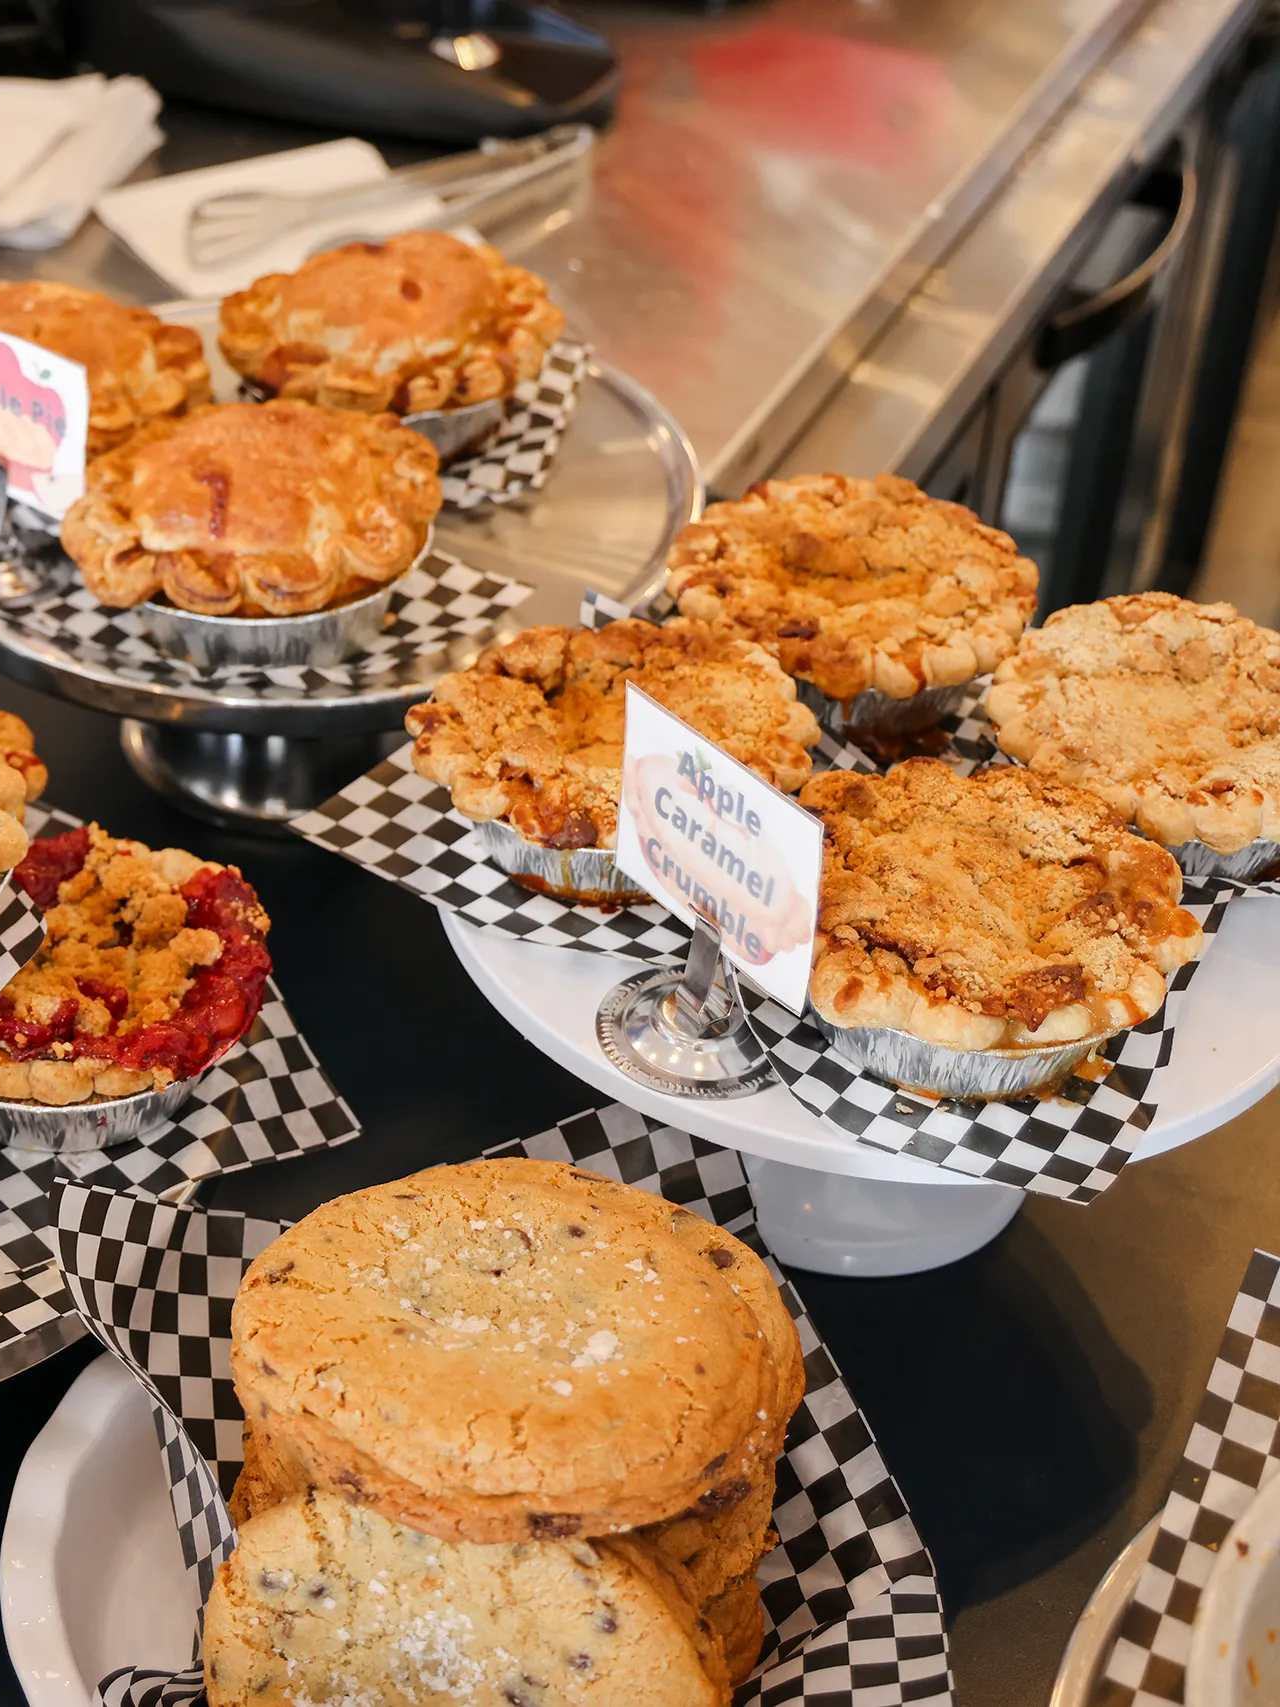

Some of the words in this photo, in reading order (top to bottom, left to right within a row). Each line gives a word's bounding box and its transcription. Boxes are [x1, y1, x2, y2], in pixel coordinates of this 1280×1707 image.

[31, 399, 67, 440] Pie
[676, 751, 762, 837] Apple
[646, 837, 763, 961] Crumble
[654, 787, 776, 908] Caramel
